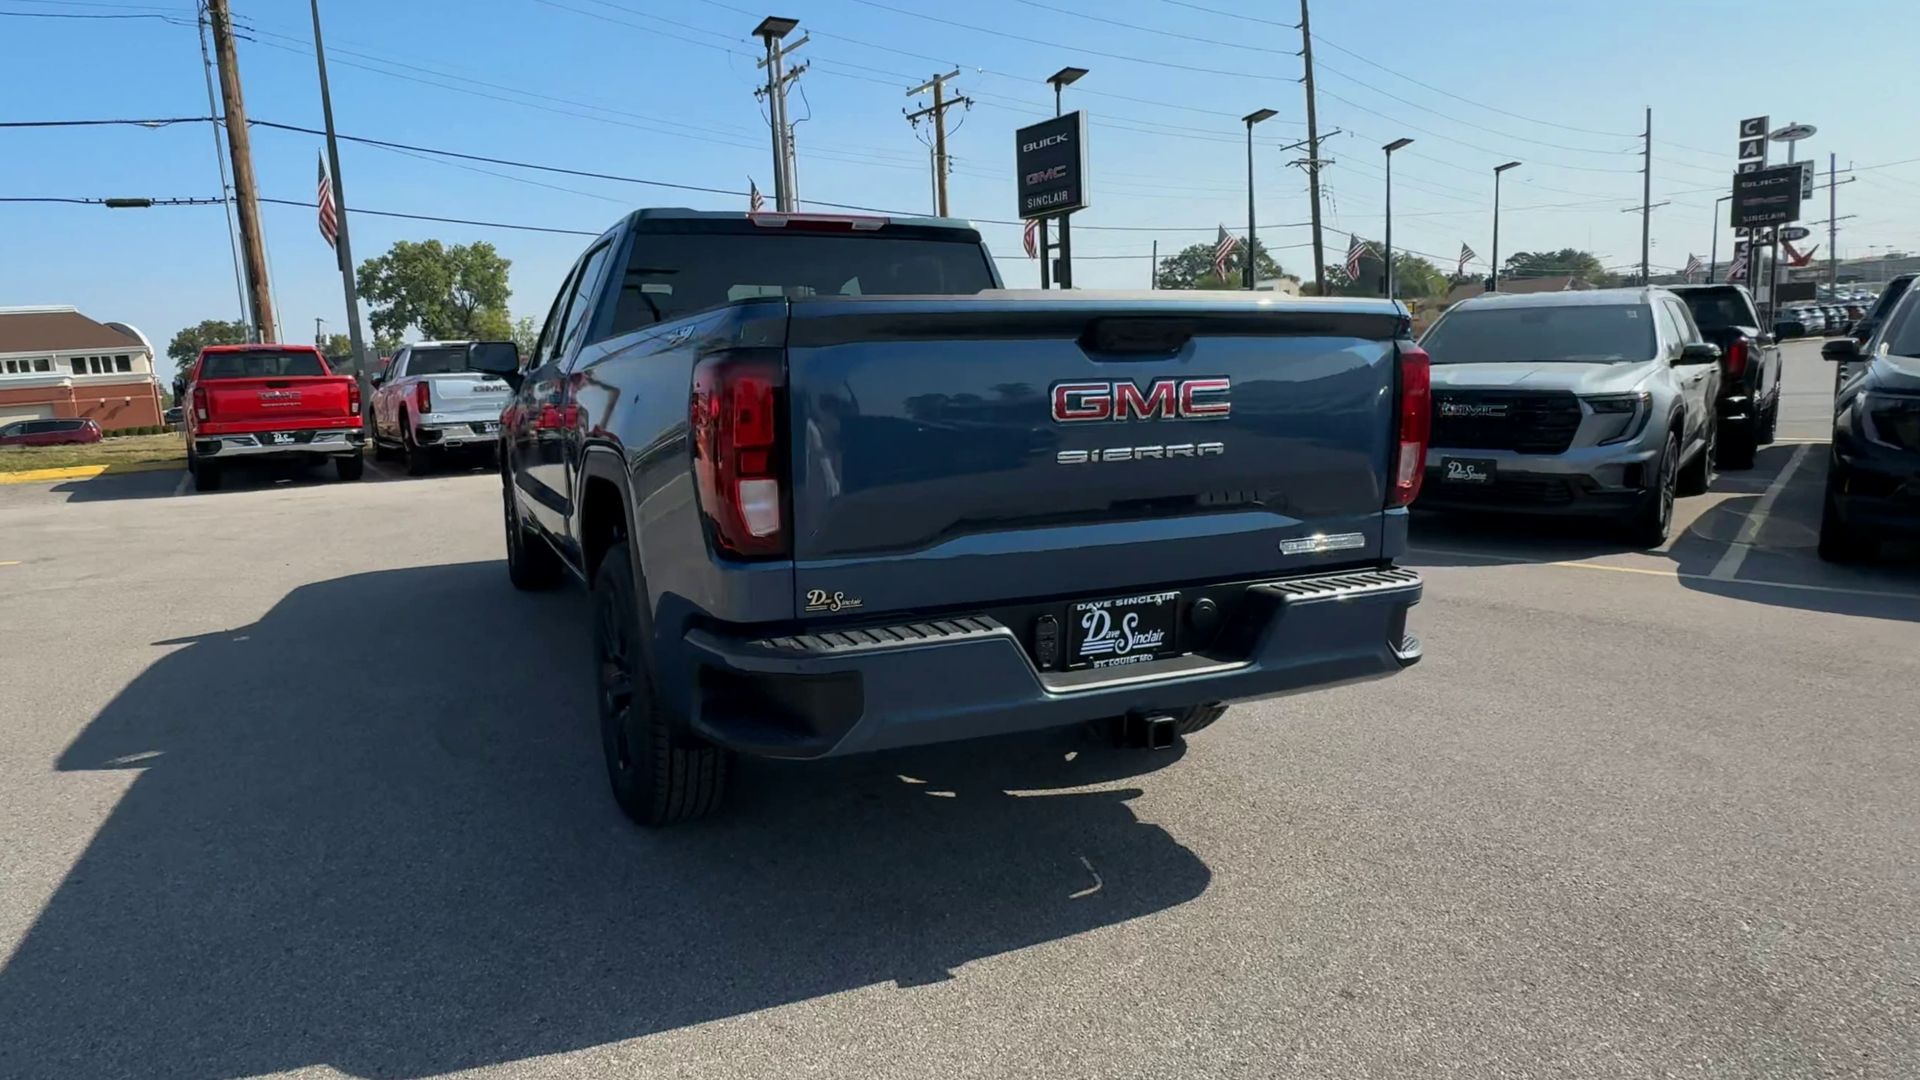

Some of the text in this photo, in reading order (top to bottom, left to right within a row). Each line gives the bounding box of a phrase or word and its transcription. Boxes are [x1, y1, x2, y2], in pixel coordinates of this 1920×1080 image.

[1023, 132, 1069, 153] BUICK
[1025, 165, 1067, 186] GMC
[1026, 190, 1069, 209] SINCLAIR
[1051, 376, 1231, 423] GMC
[1056, 442, 1225, 464] SIERRA
[1076, 593, 1176, 612] DAVE SINCLAIR
[1081, 609, 1165, 655] Dave Sinclair
